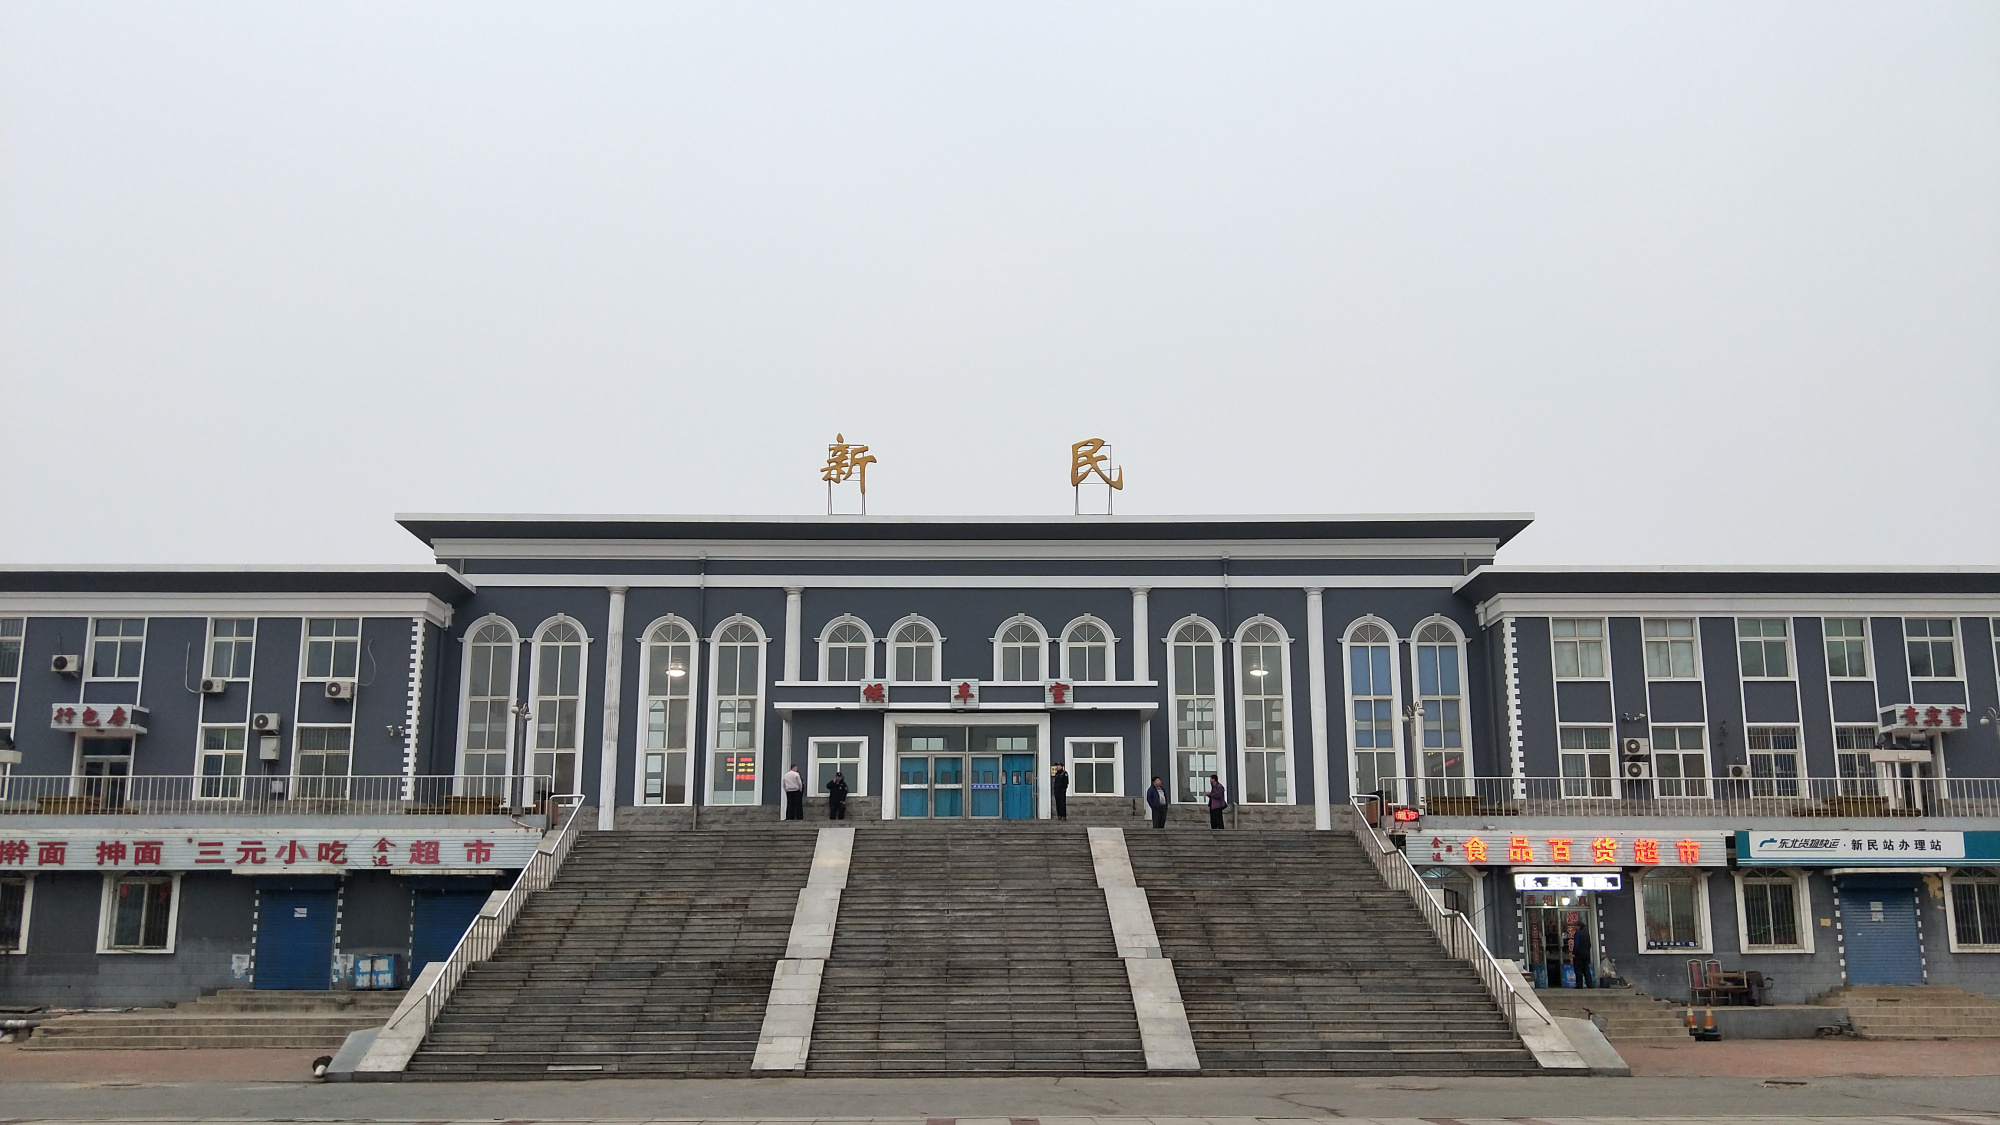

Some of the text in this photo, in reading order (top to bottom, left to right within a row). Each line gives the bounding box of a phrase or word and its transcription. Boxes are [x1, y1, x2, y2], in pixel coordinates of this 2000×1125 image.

[820, 433, 1123, 493] 新民
[863, 681, 1070, 705] 候车室
[54, 705, 128, 727] 行包房
[1899, 705, 1966, 727] 贵宾室
[194, 839, 348, 865] 三元小吃
[409, 839, 495, 865] 超市
[1463, 836, 1701, 865] 食品百货超市
